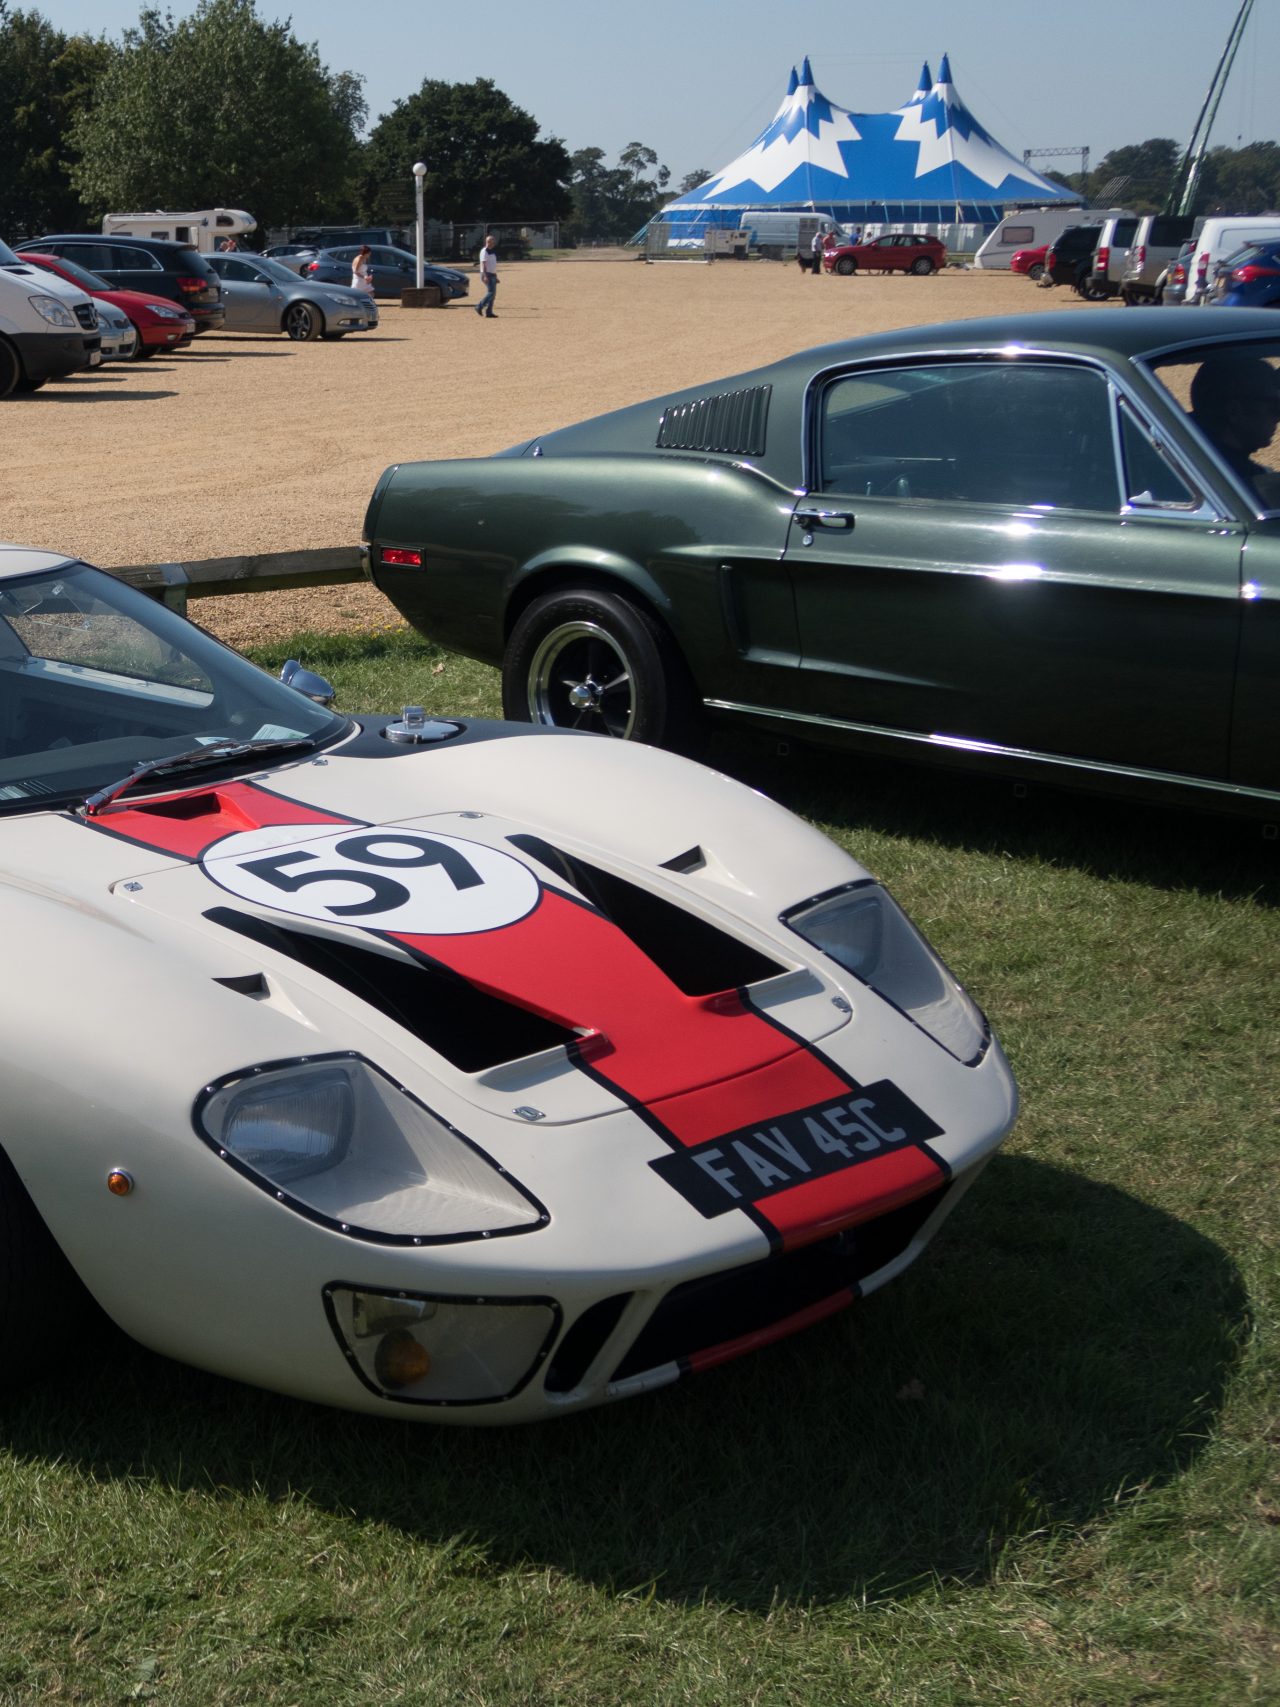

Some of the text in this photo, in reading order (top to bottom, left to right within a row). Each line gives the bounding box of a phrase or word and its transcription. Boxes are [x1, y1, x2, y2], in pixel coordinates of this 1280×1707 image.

[236, 834, 486, 916] 59
[690, 1097, 907, 1199] FAV 45C
